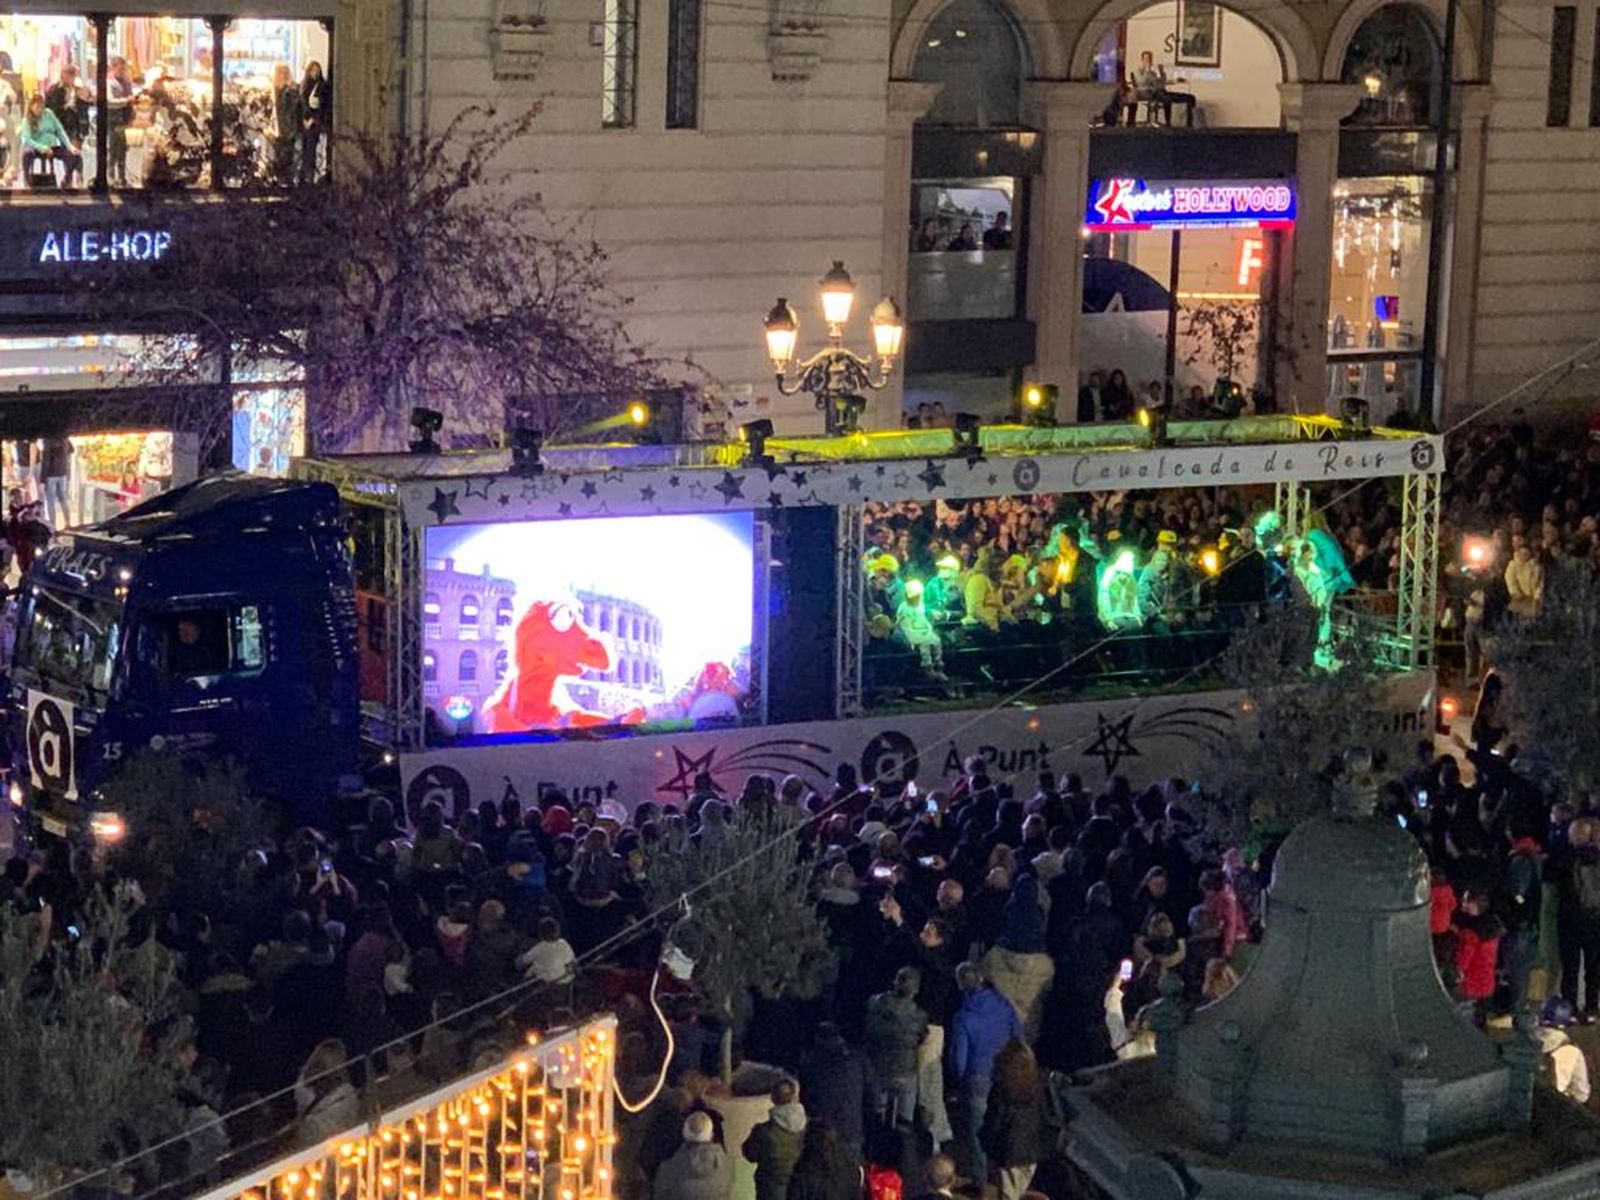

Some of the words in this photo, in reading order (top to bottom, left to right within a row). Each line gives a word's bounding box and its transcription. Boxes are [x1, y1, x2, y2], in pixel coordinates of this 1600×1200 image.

[1173, 186, 1291, 213] HOLLYWOOD
[39, 231, 172, 262] ALE-HOP
[1264, 450, 1295, 473] de
[1317, 444, 1385, 476] Reis
[102, 742, 122, 760] 15
